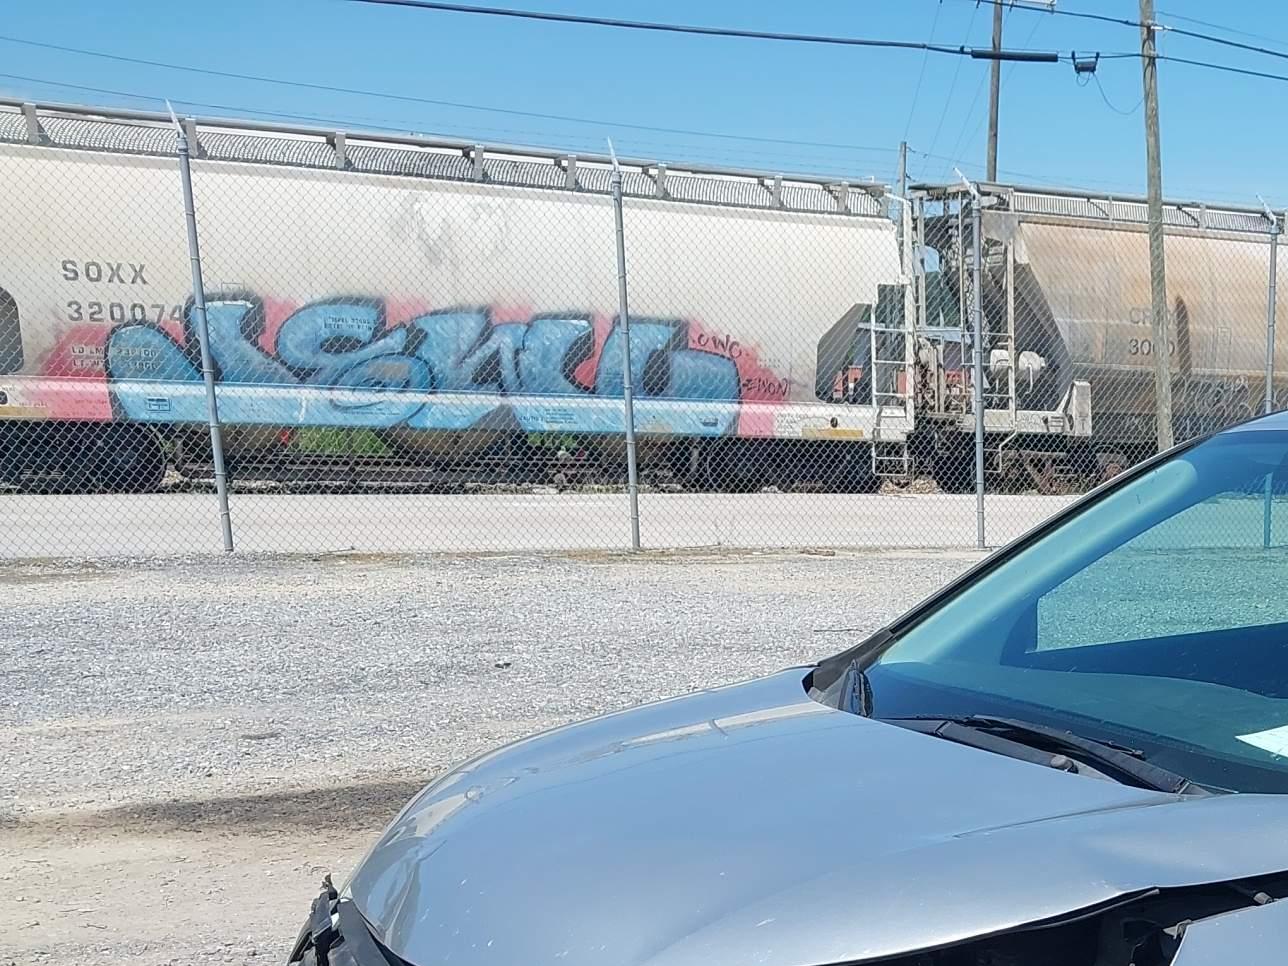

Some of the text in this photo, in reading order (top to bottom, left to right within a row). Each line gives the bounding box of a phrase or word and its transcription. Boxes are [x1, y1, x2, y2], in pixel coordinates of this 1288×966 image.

[61, 259, 150, 284] SOXX
[66, 300, 186, 323] 320074
[1128, 337, 1176, 357] 300
